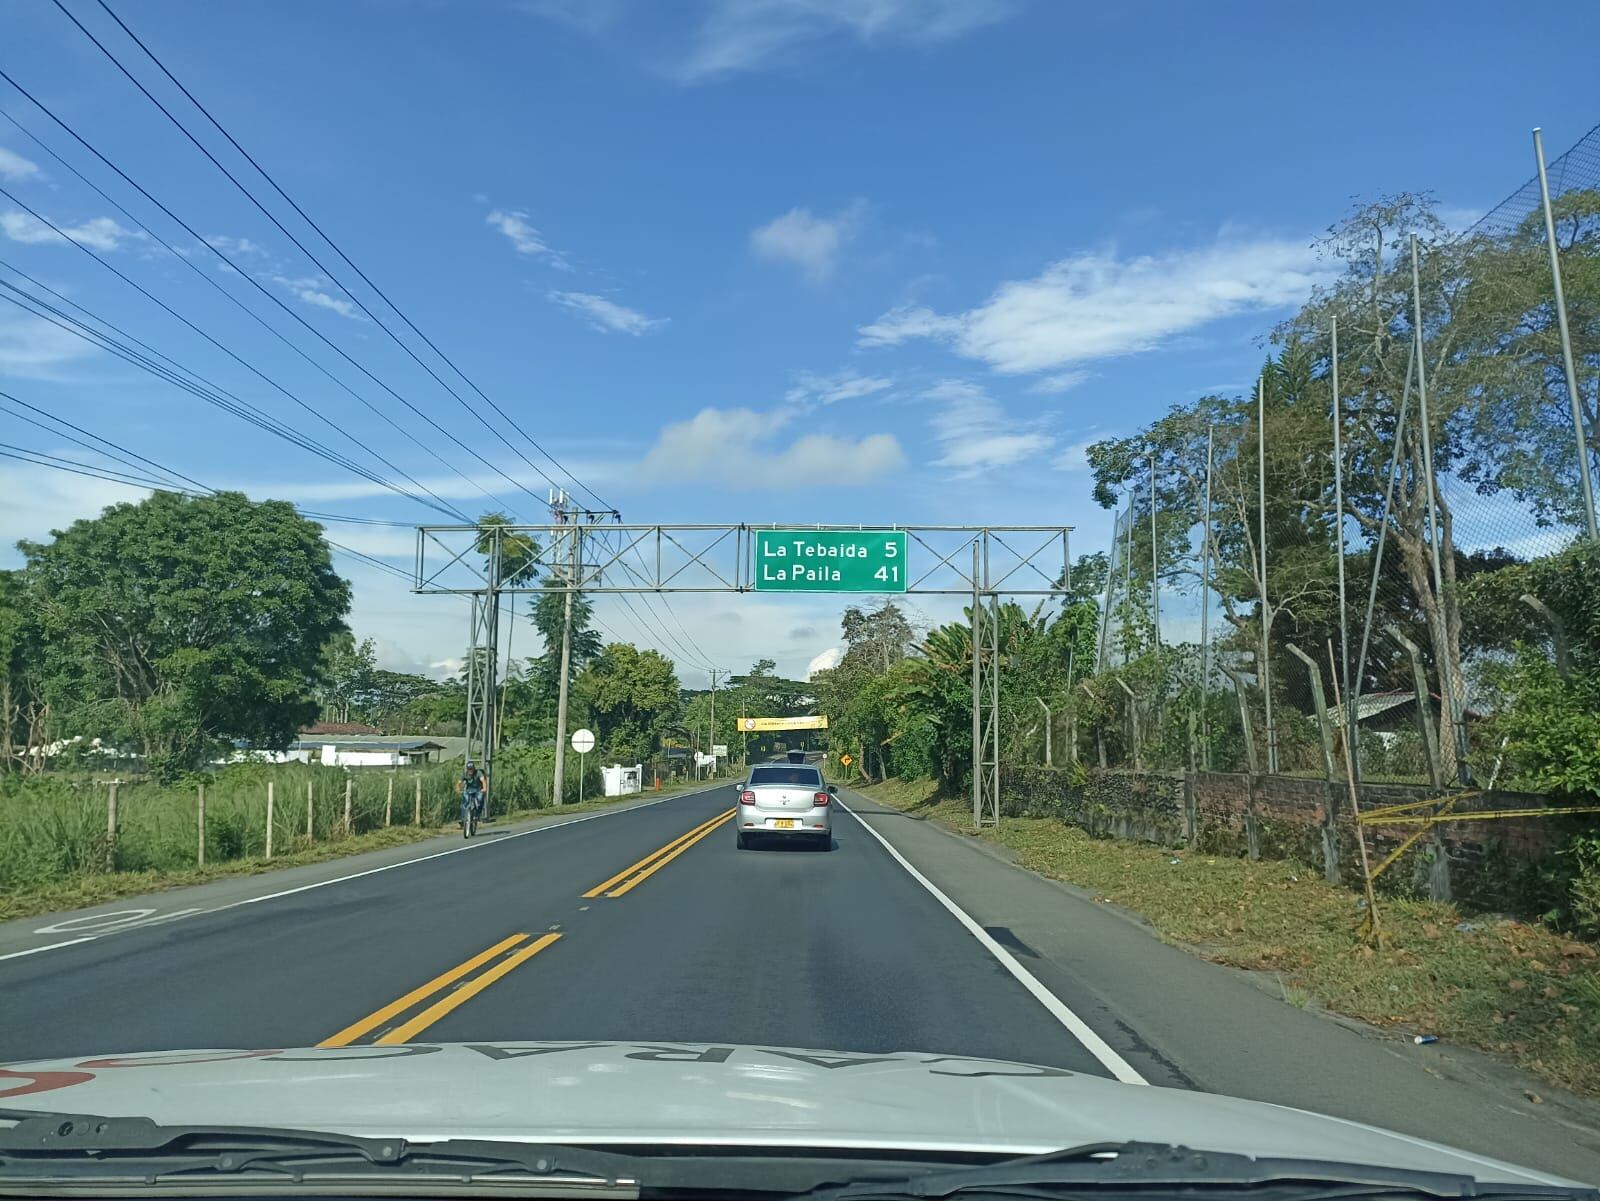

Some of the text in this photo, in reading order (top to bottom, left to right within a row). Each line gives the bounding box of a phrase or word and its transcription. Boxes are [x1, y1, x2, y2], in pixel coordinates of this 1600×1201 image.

[764, 541, 897, 558] La Tebaida 5
[763, 564, 898, 582] La Paila 41
